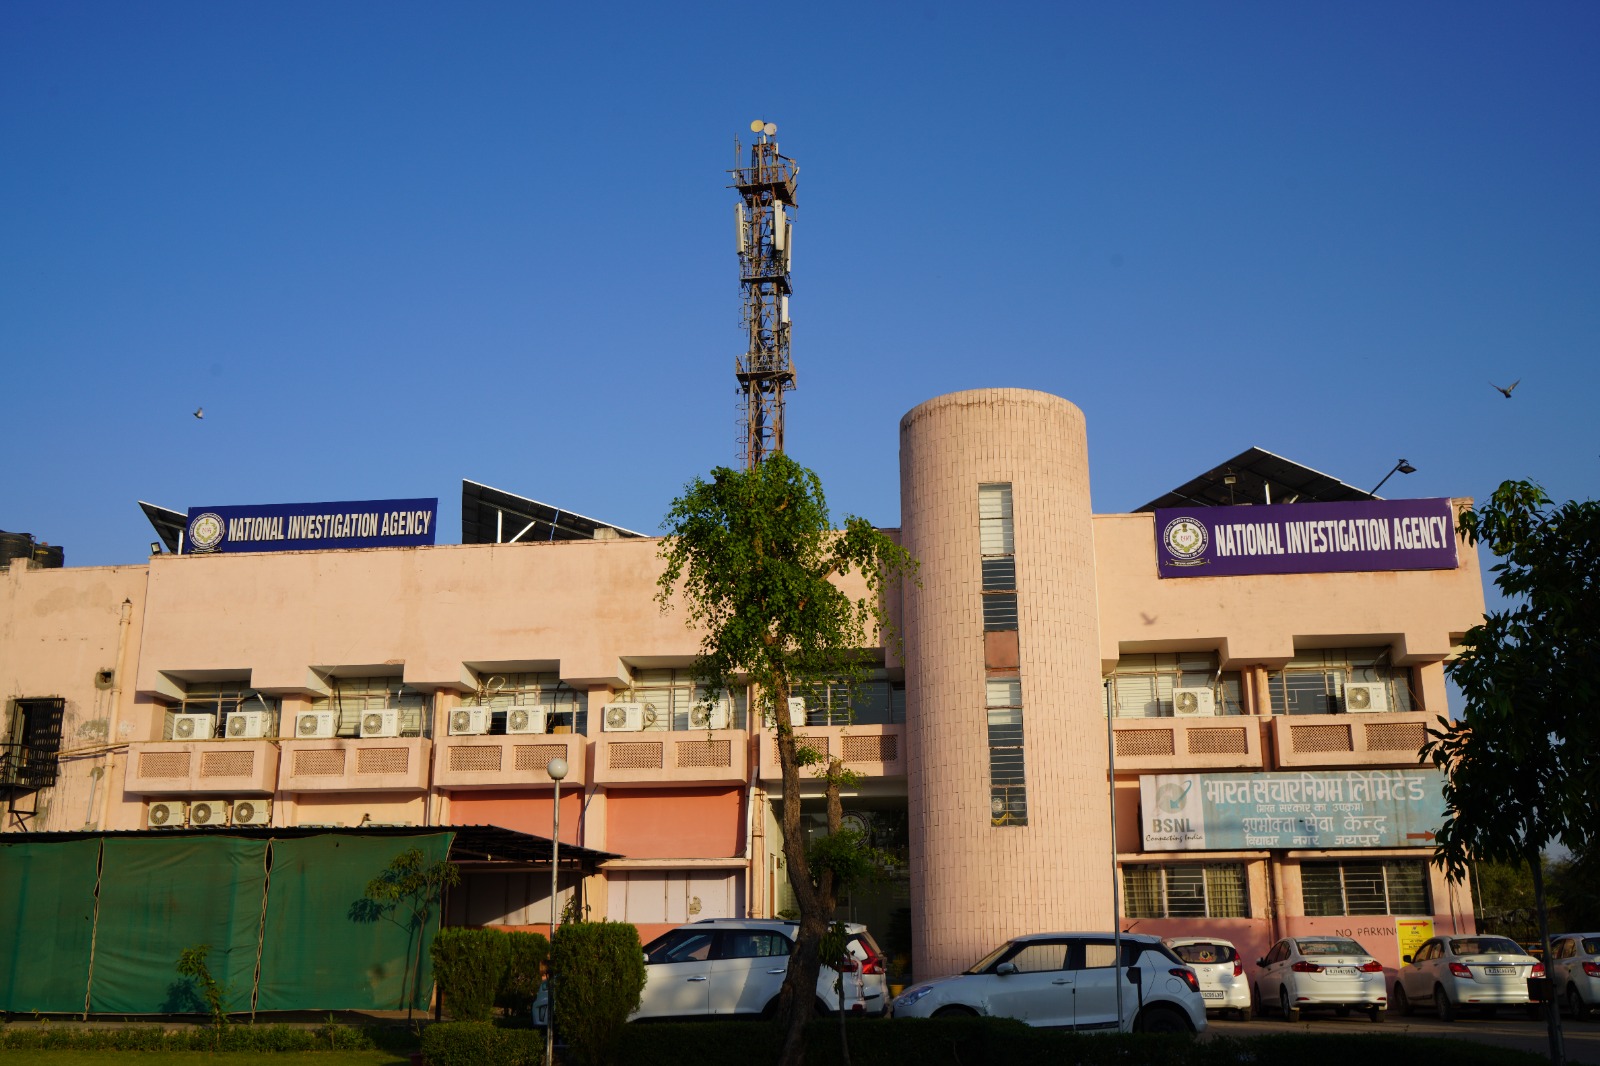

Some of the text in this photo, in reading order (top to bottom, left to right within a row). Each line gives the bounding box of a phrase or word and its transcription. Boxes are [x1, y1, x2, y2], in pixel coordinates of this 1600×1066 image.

[228, 517, 284, 542] NATIONAL
[287, 512, 378, 539] INVESTIGATION
[381, 510, 431, 536] AGENCY
[1215, 516, 1447, 556] NATIONAL INVESTIGATION AGENCY
[1204, 771, 1425, 804] भारत संचार निगम लिमिटेड
[1279, 803, 1311, 813] सरकार
[1152, 818, 1195, 833] BSNL
[1242, 813, 1296, 833] उपभोक्ता
[1304, 812, 1334, 833] सेवा
[1145, 832, 1203, 843] Connecting India
[1334, 834, 1380, 847] जयपुर
[1336, 927, 1397, 937] NO PARKIN
